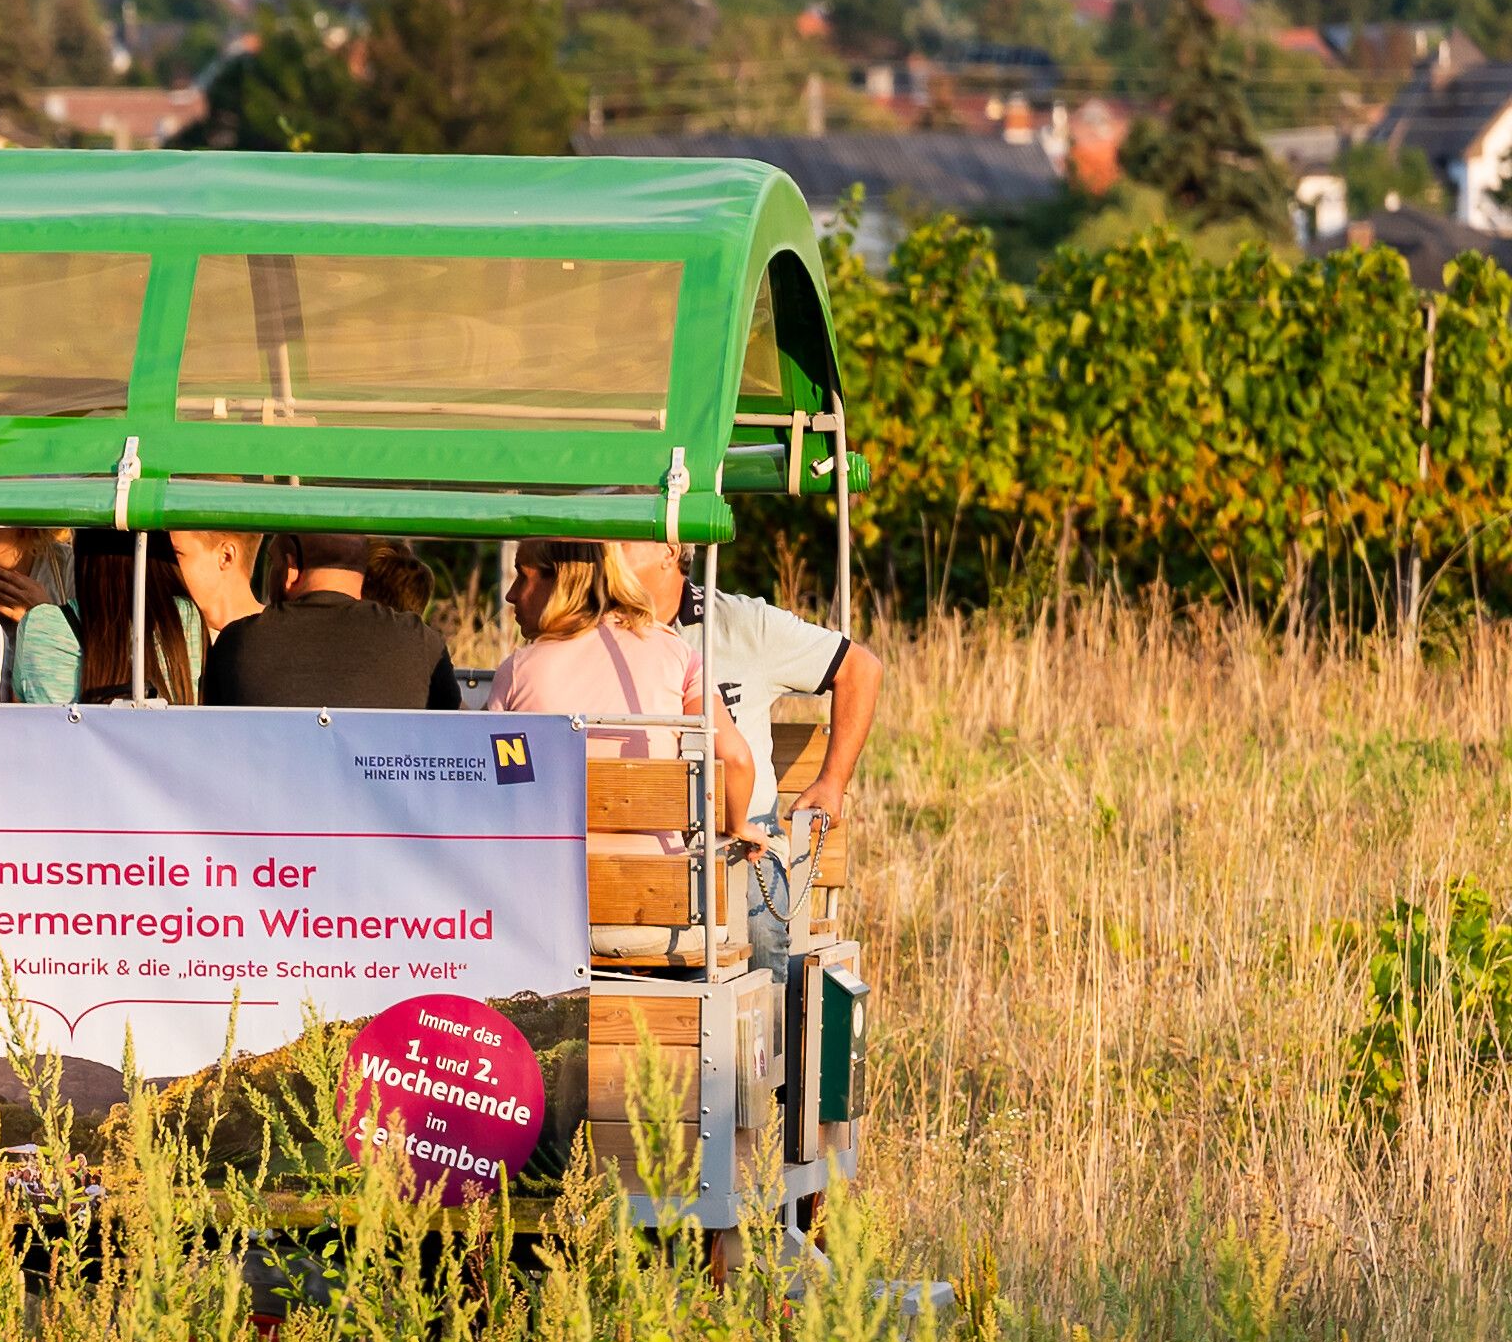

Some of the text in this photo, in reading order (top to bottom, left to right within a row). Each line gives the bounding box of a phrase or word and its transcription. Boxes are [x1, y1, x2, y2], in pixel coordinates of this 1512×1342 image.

[354, 754, 486, 768] NIEDERÖSTERREICH
[364, 769, 487, 782] HINEIN INS LEBEN.
[205, 856, 237, 887] in
[252, 857, 317, 888] der
[259, 907, 493, 940] Wienerwald
[14, 958, 109, 976] Kulinarik
[116, 959, 131, 976] &
[138, 959, 170, 977] die
[276, 961, 356, 979] Schank
[364, 961, 400, 979] der
[418, 1009, 502, 1047] Immer das
[405, 1039, 499, 1085] 1. und 2.
[361, 1052, 531, 1125] Wochenende
[425, 1112, 447, 1133] im
[354, 1116, 502, 1180] Setember
